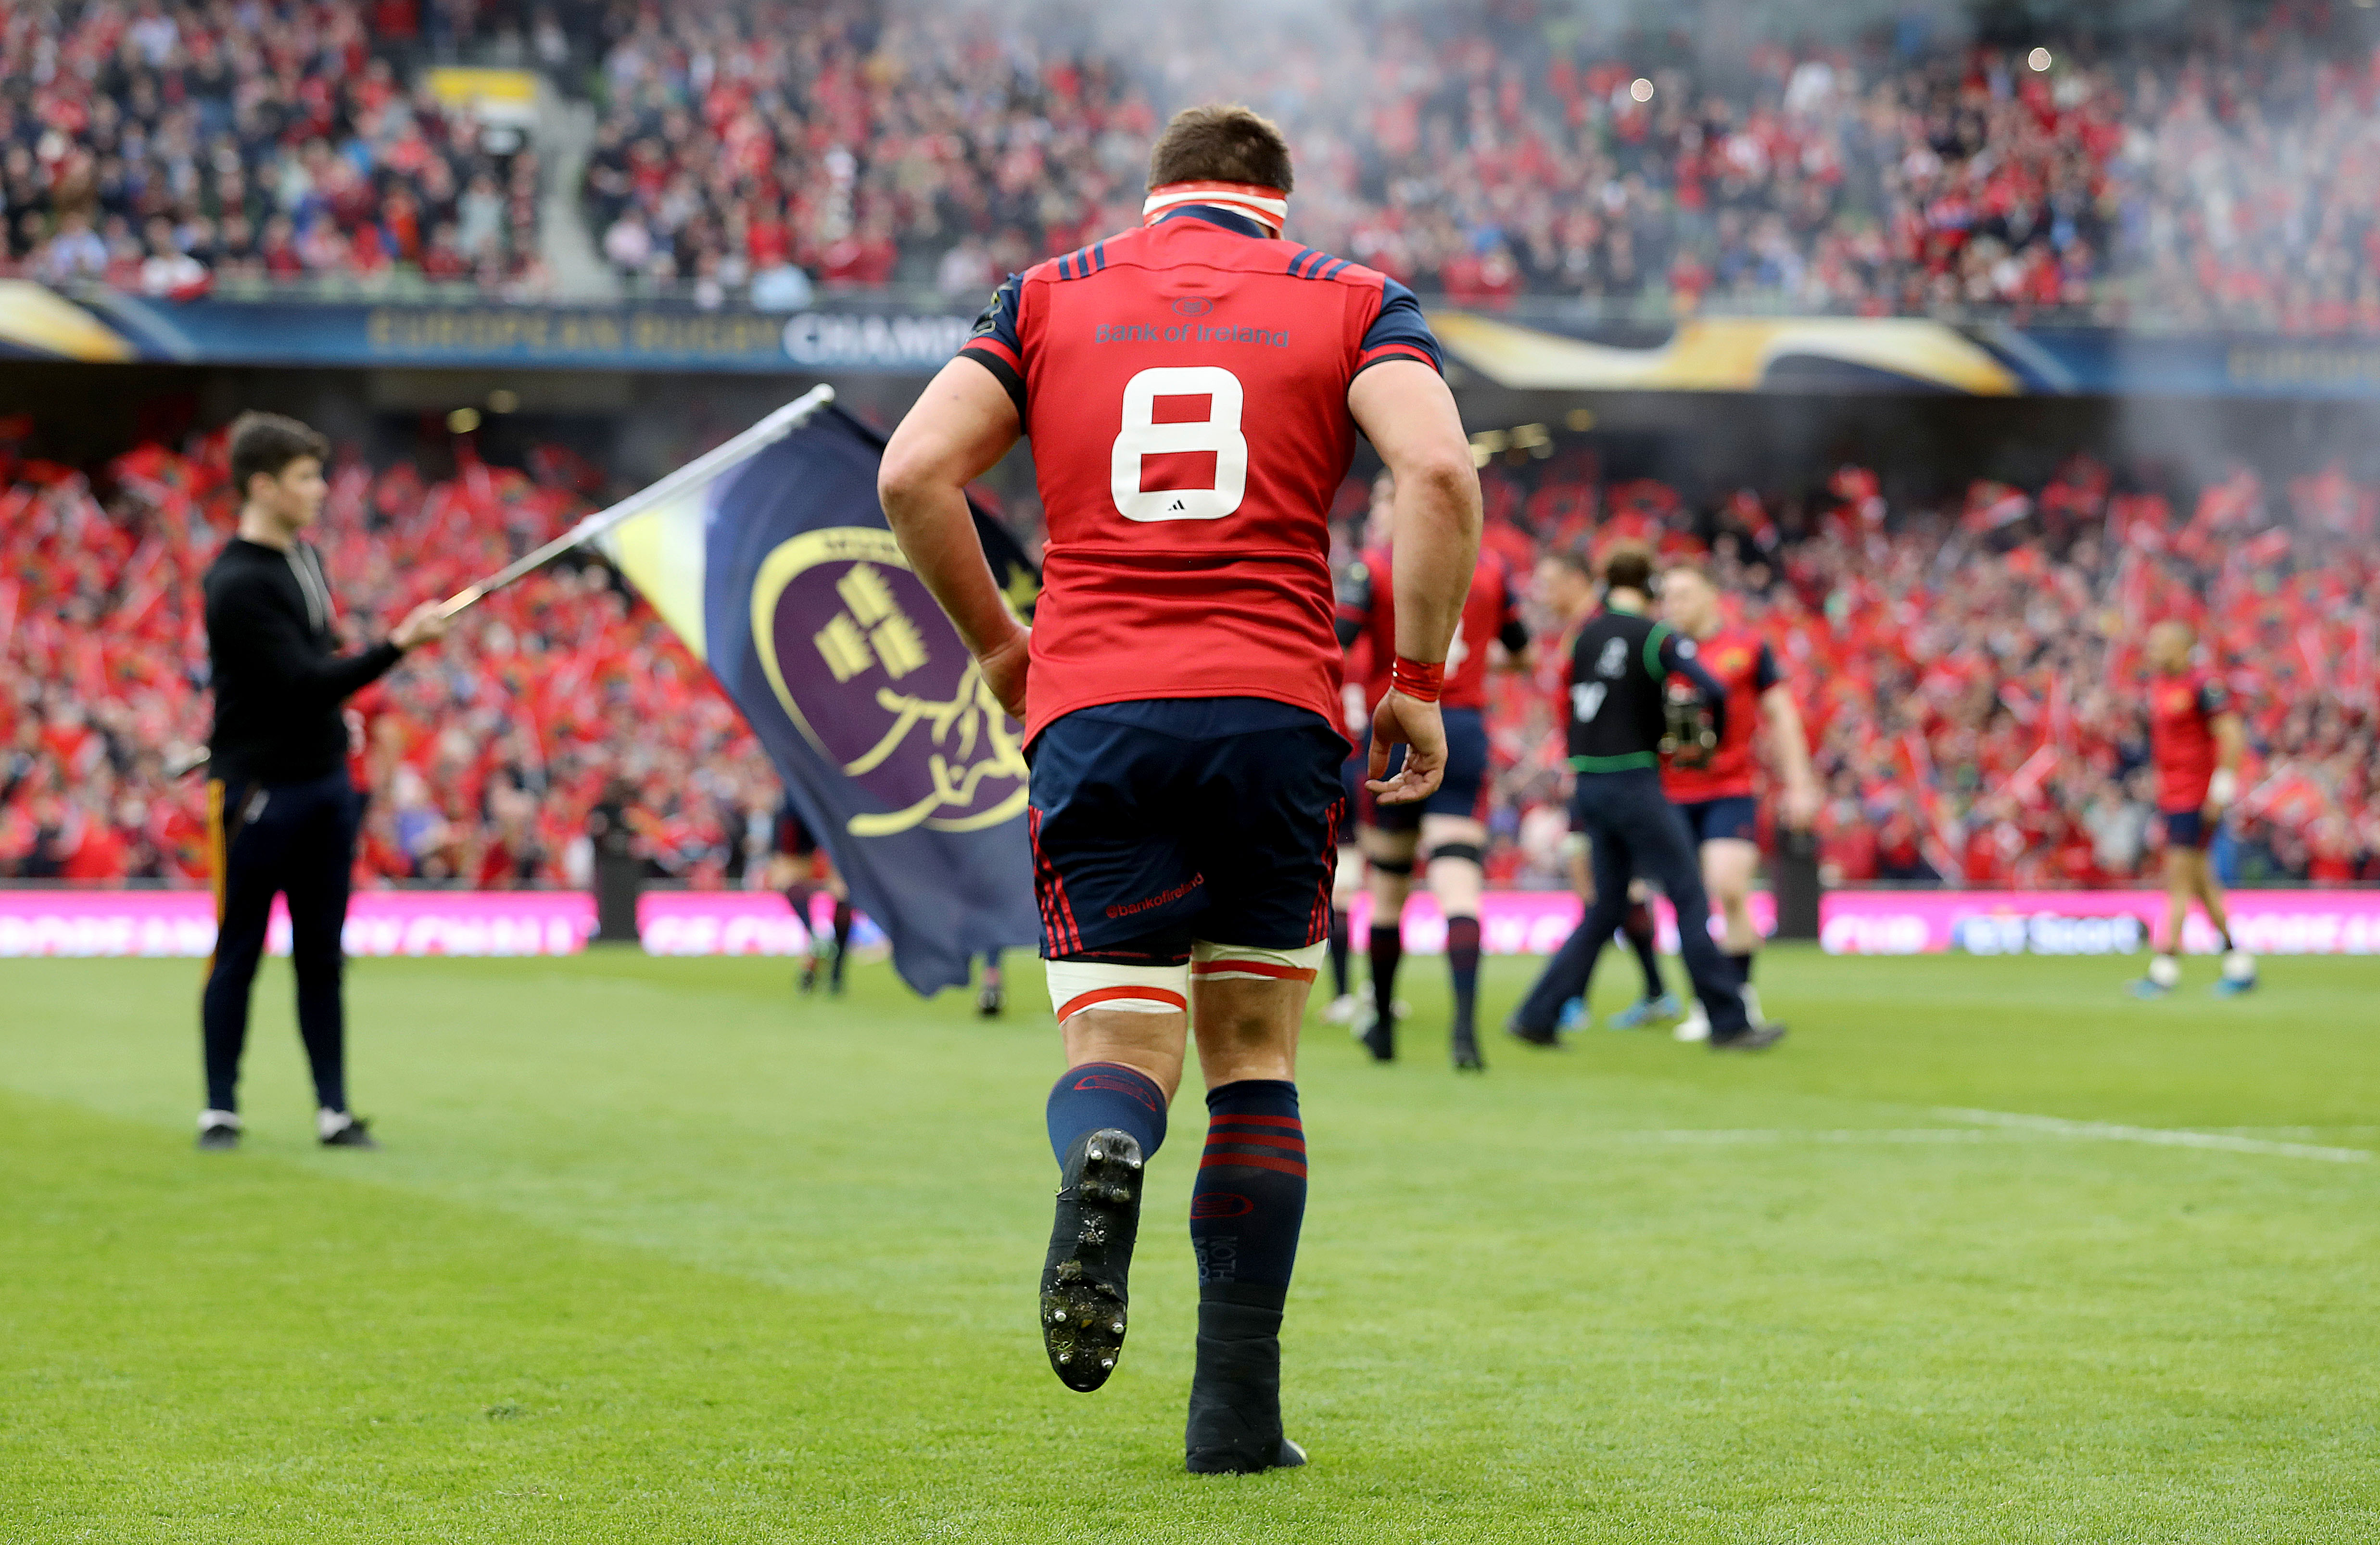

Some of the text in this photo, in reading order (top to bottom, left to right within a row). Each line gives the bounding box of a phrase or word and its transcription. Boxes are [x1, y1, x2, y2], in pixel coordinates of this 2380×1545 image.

[1095, 323, 1290, 348] Bank of Ireland
[1111, 365, 1248, 522] 8
